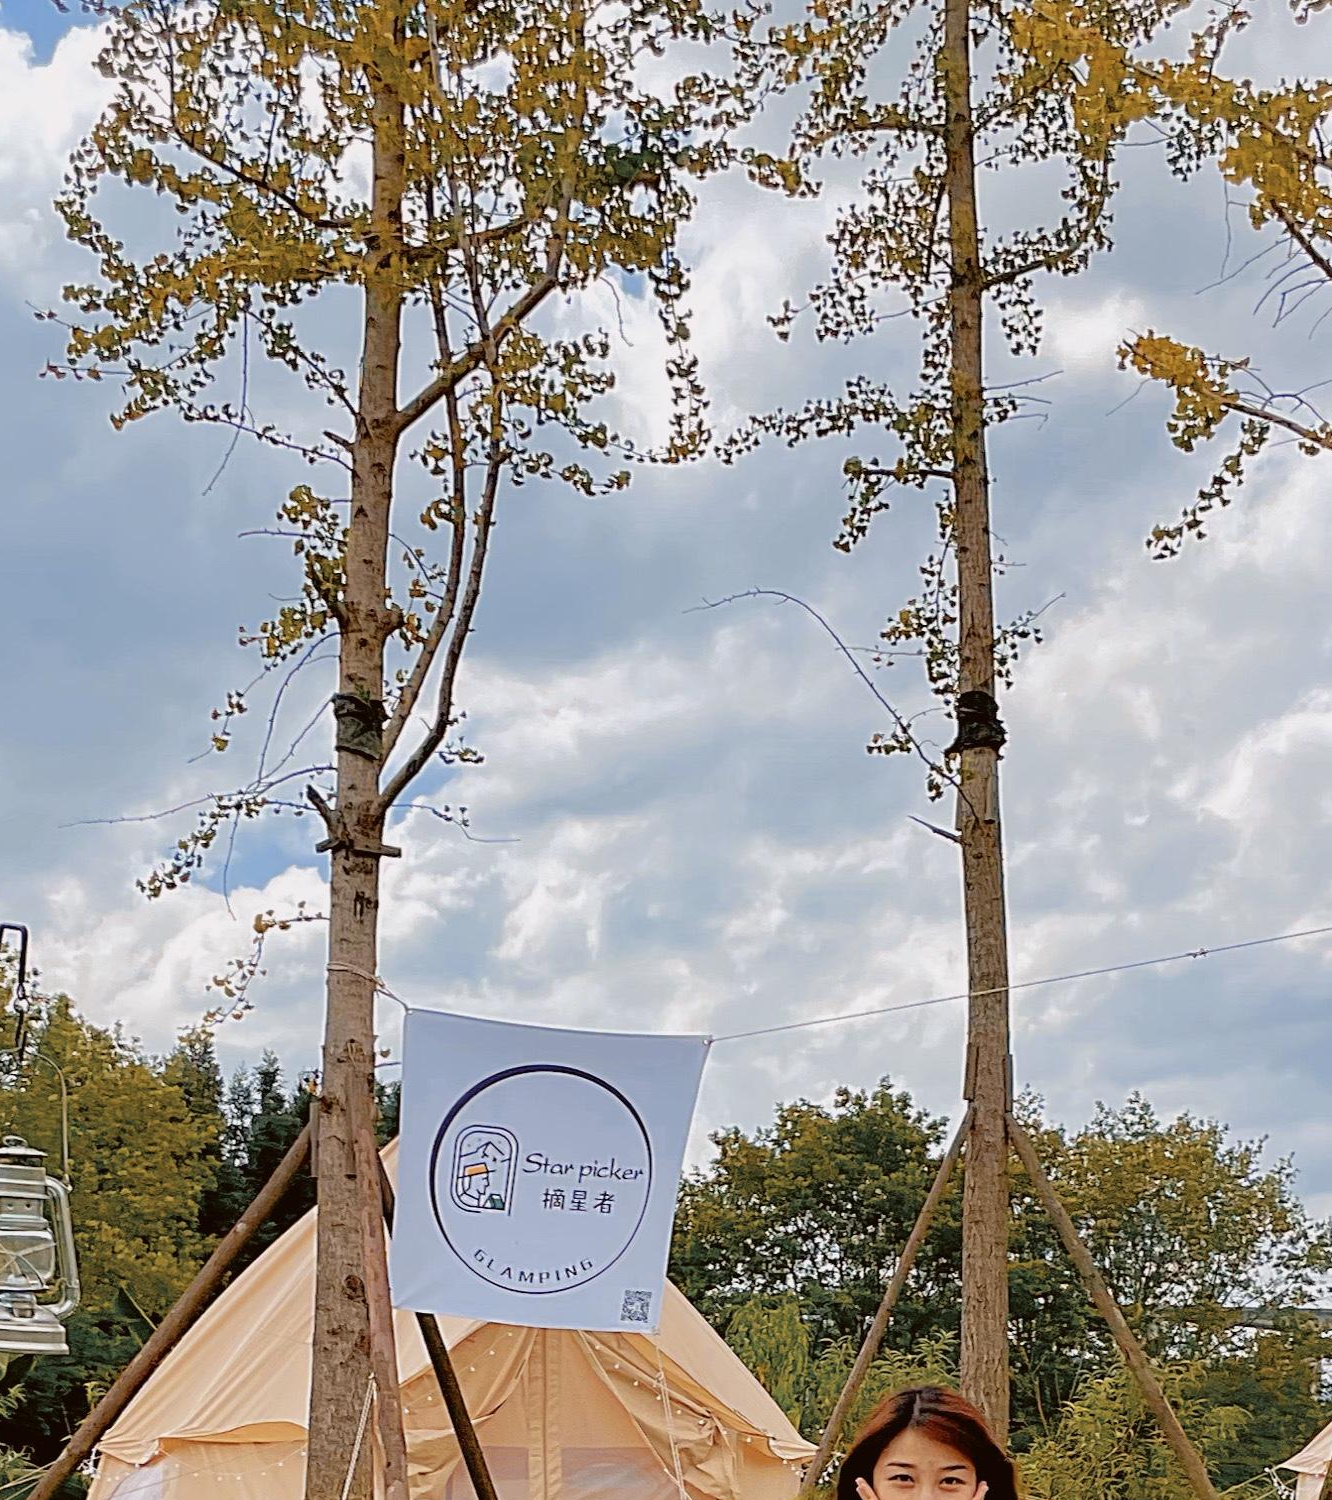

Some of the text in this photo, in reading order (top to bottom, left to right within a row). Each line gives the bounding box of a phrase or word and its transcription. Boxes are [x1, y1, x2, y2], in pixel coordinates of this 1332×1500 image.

[523, 1153, 644, 1183] Star picker
[542, 1188, 616, 1214] 摘星者
[474, 1249, 594, 1284] GLAMPING
